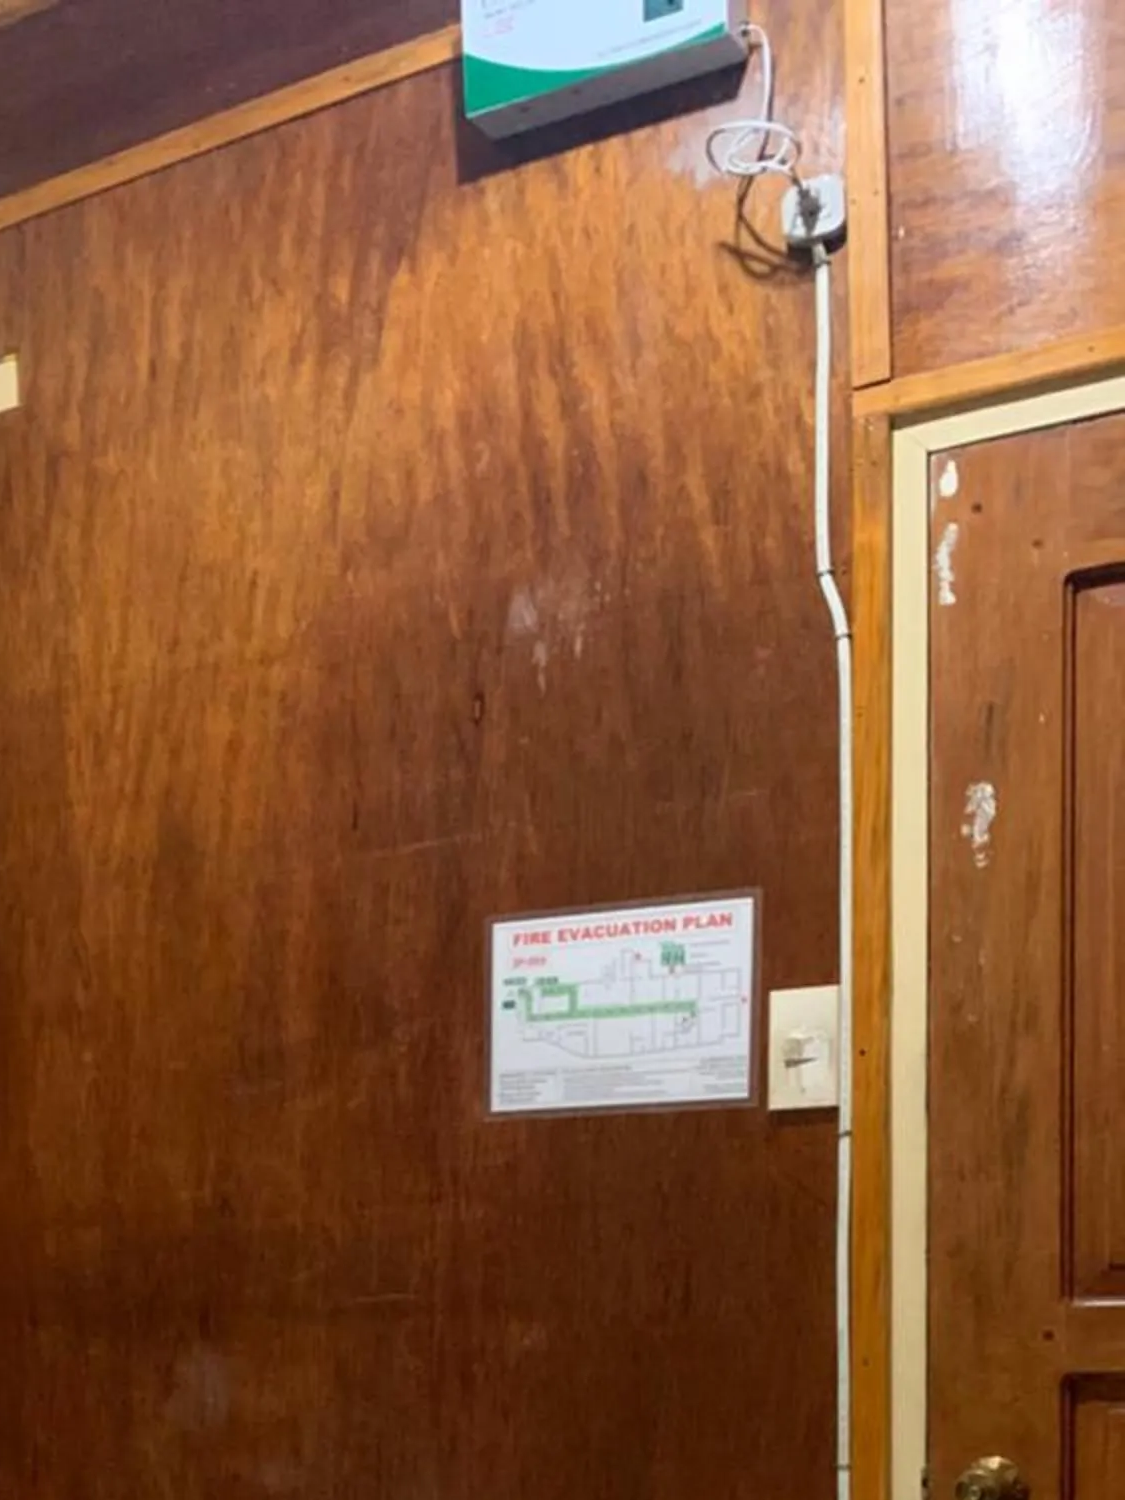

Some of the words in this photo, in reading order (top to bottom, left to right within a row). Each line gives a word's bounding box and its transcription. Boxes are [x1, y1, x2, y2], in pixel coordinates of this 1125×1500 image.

[512, 931, 552, 947] FIRE
[558, 918, 677, 943] EVACUATION
[682, 912, 733, 929] PLAN
